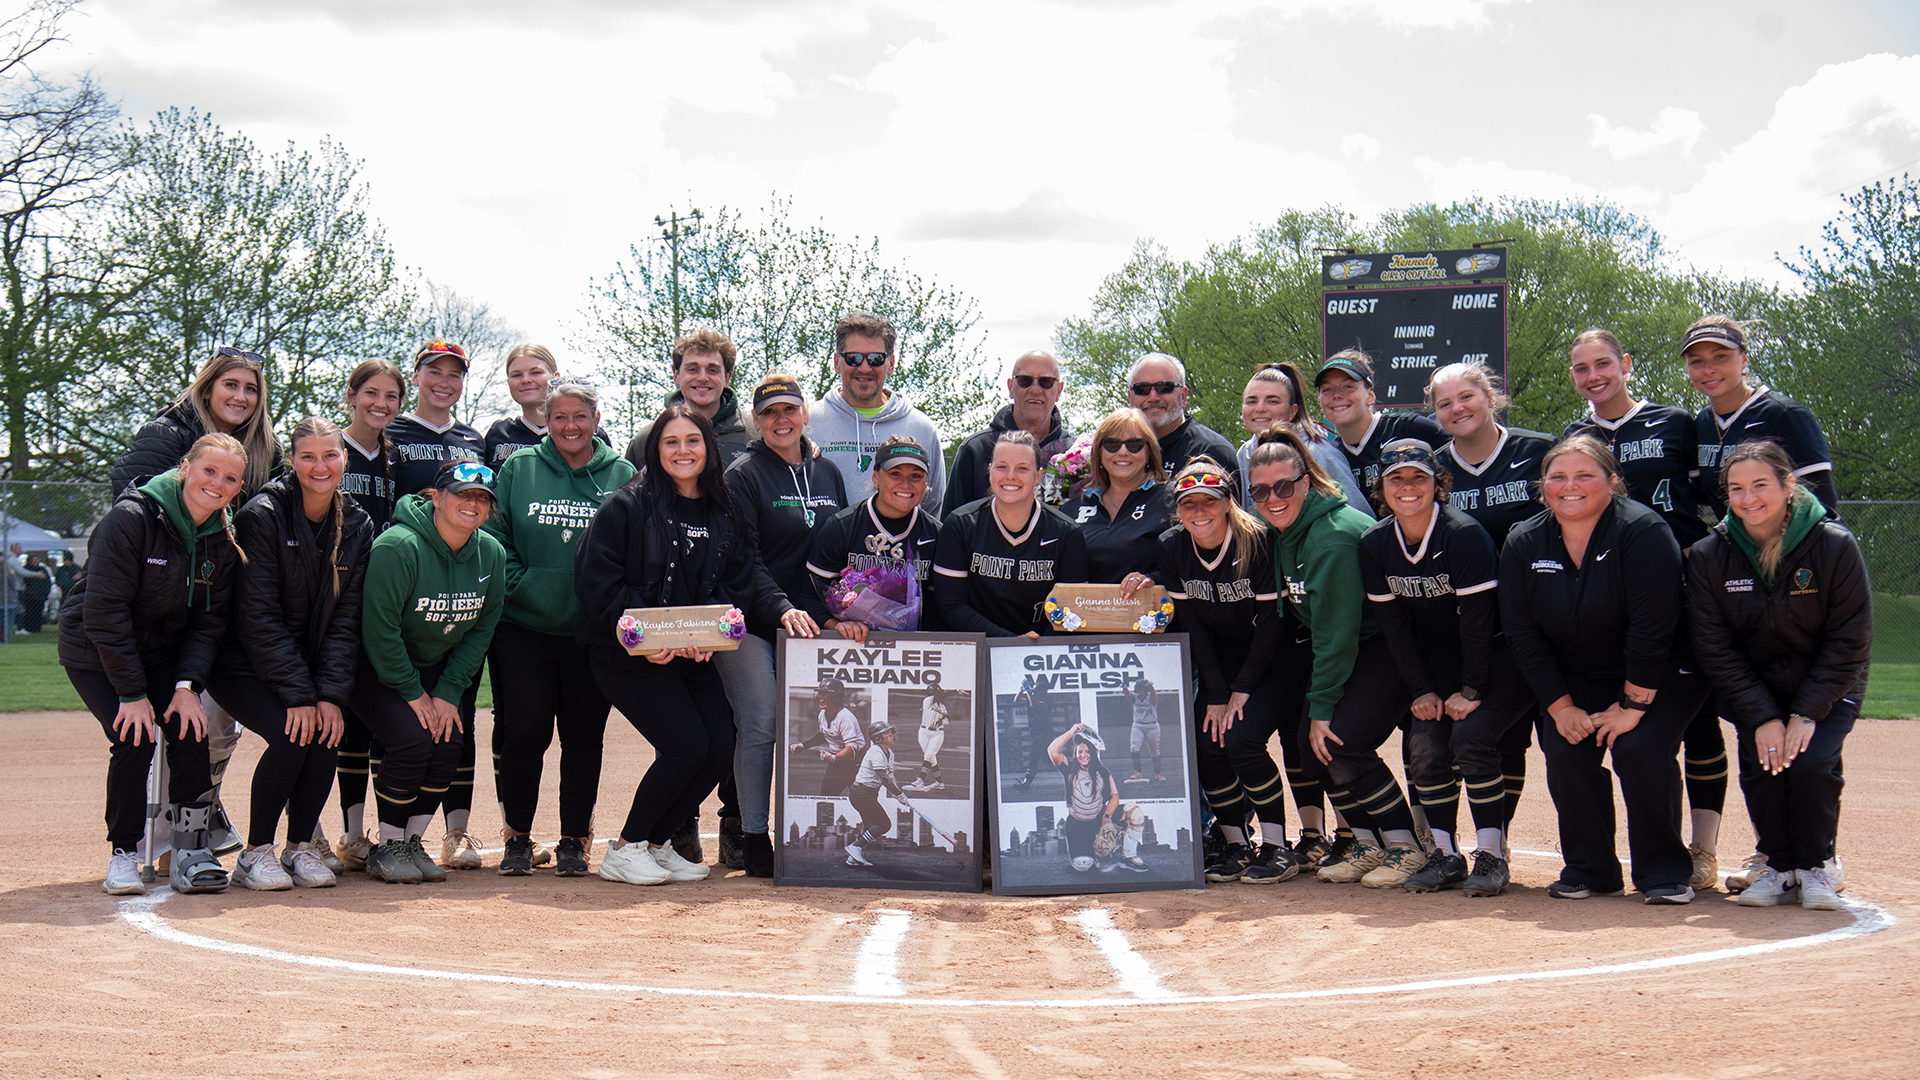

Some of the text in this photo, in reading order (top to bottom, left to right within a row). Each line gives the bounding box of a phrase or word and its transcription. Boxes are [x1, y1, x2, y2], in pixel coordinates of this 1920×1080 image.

[1389, 253, 1439, 270] Kennedy
[1380, 268, 1447, 281] GIRLS SOFTBALL
[1327, 298, 1379, 315] GUEST
[1452, 293, 1498, 310] HOME
[1394, 324, 1435, 339] INNING
[1391, 355, 1438, 369] STRIKE
[1387, 385, 1397, 398] H
[398, 443, 444, 463] POINT
[1620, 438, 1664, 463] PARK
[341, 472, 371, 495] OINT
[1485, 480, 1529, 506] PARK
[1652, 478, 1673, 512] 4
[527, 502, 598, 517] PIONEER
[970, 552, 1054, 581] POINT PARK
[1216, 578, 1255, 603] PARK
[1725, 579, 1754, 587] ATHLETIC
[1075, 596, 1112, 608] Gianna
[642, 618, 717, 632] Kaylee Fabiano
[817, 648, 942, 667] KAYLEE
[1023, 652, 1144, 671] GIANNA
[817, 668, 942, 685] FABIANO
[1024, 671, 1145, 689] WELSH
